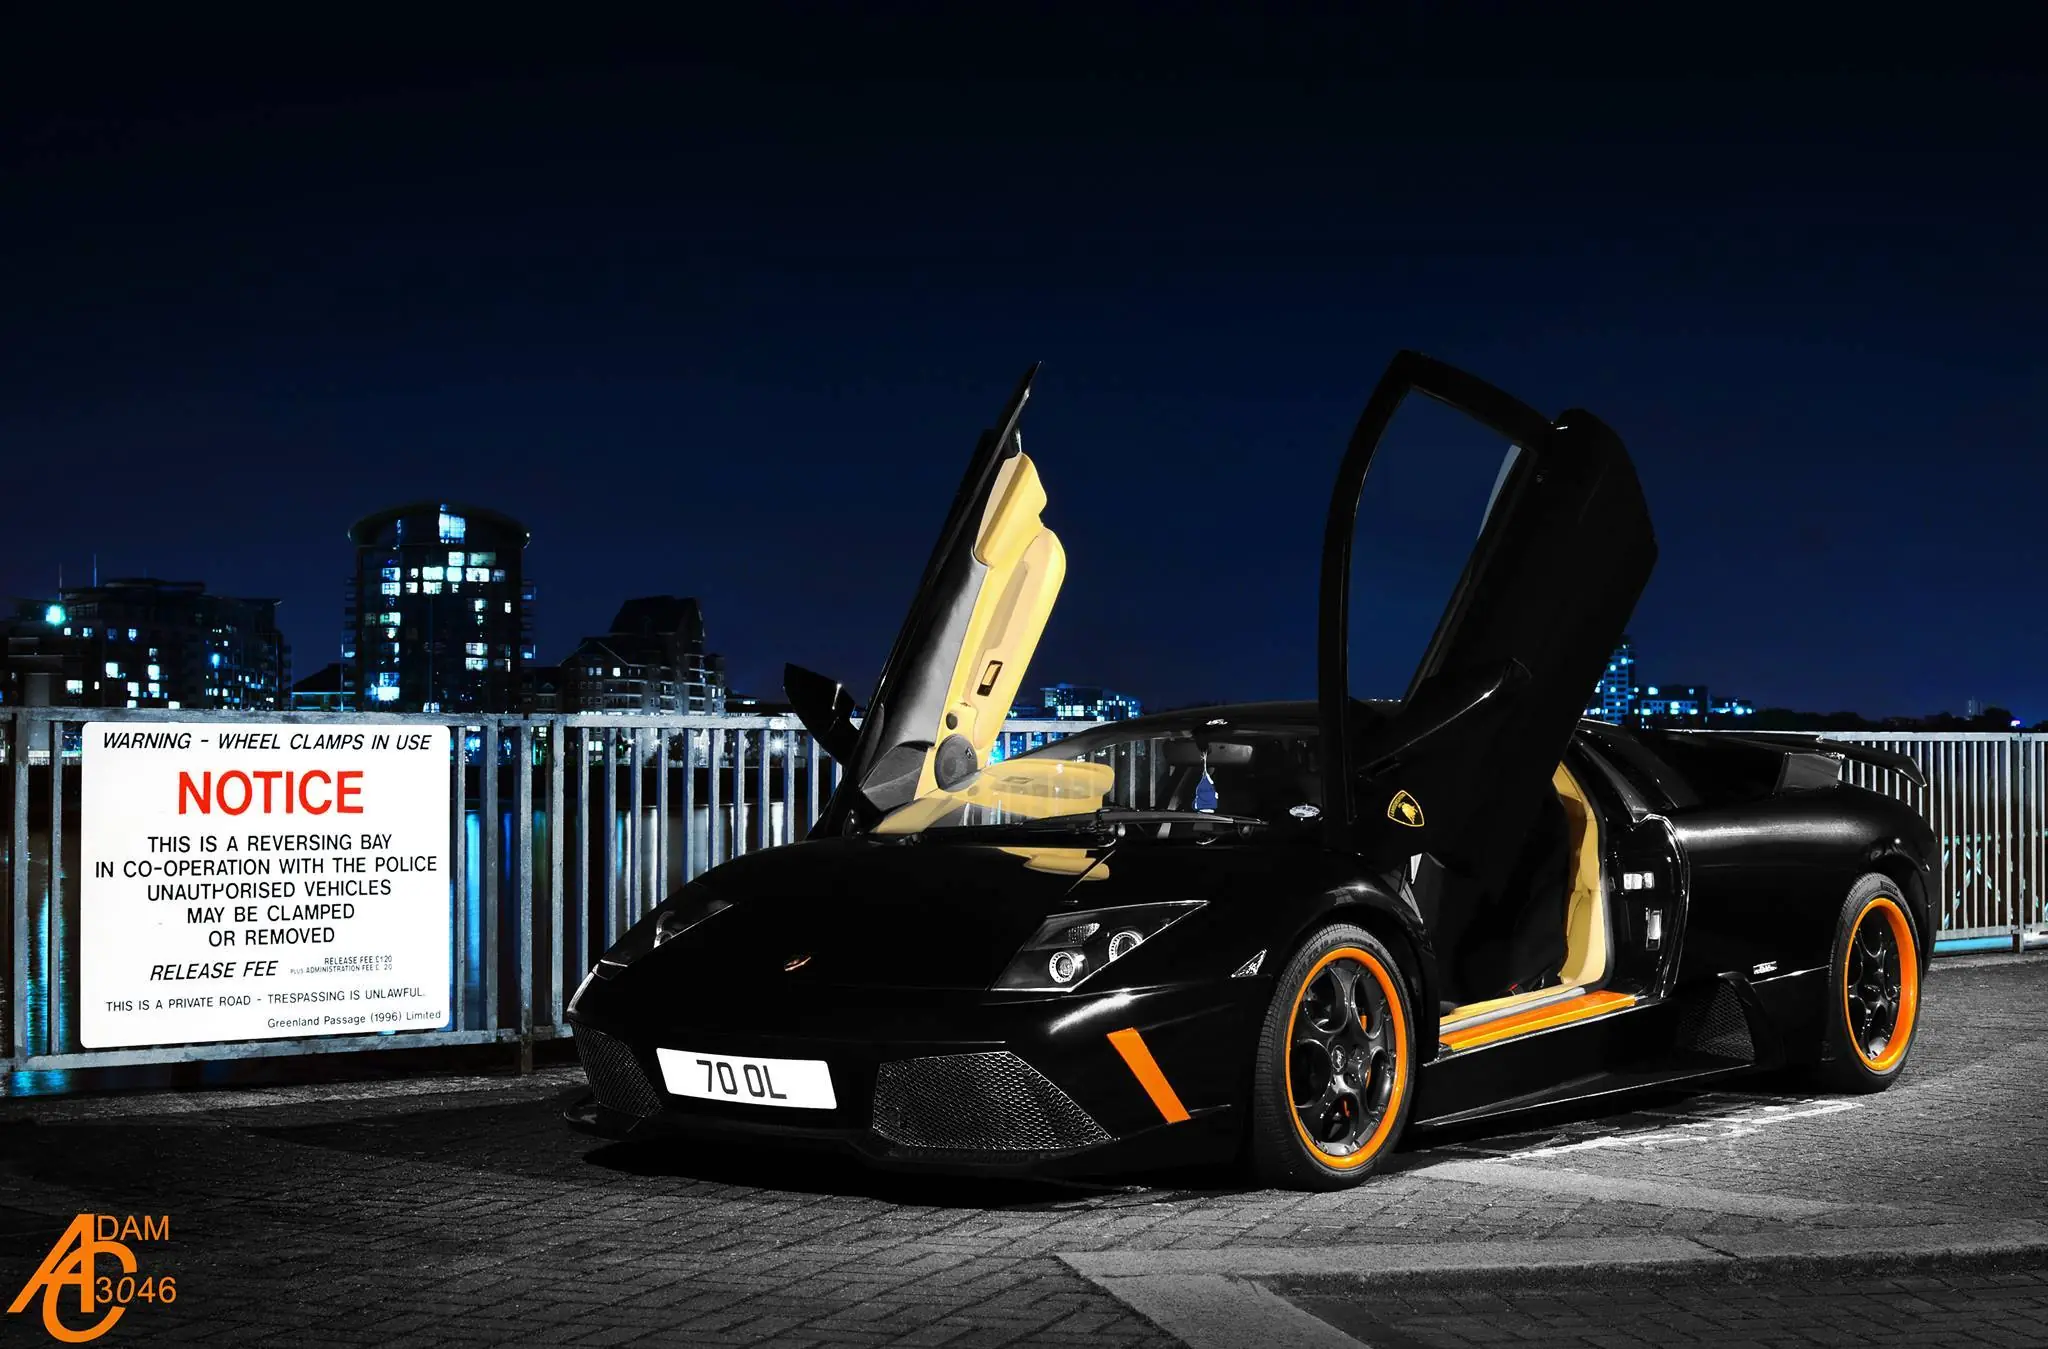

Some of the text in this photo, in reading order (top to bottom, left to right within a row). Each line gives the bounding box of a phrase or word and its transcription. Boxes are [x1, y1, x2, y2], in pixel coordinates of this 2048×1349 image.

[103, 732, 191, 749] WARNING
[218, 734, 281, 750] WHEEL
[290, 734, 363, 750] CLAMPS
[371, 735, 390, 750] IN
[396, 735, 432, 750] USE
[178, 770, 363, 816] NOTICE
[148, 834, 392, 853] THIS IS A REVERSING BAY
[96, 856, 437, 878] IN CO-OPERATION WITH THE POLICE
[147, 880, 391, 901] UNAUTHORISED VEHICLES
[187, 904, 355, 924] MAY BE CLAMPED
[208, 928, 335, 947] OR REMOVED
[305, 964, 360, 974] ADMINISTRATION
[362, 963, 374, 971] FEE
[324, 957, 358, 965] RELEASE
[360, 955, 373, 964] FEE
[150, 960, 279, 981] RELEASE FEE
[106, 1001, 133, 1012] THIS
[139, 1000, 150, 1011] IS
[155, 1000, 163, 1010] A
[168, 997, 214, 1009] PRIVATE
[218, 995, 251, 1007] ROAD
[267, 990, 345, 1005] TRESPASSING
[349, 990, 360, 1000] IS
[267, 1010, 441, 1029] Greenland Passage (1996) Limited
